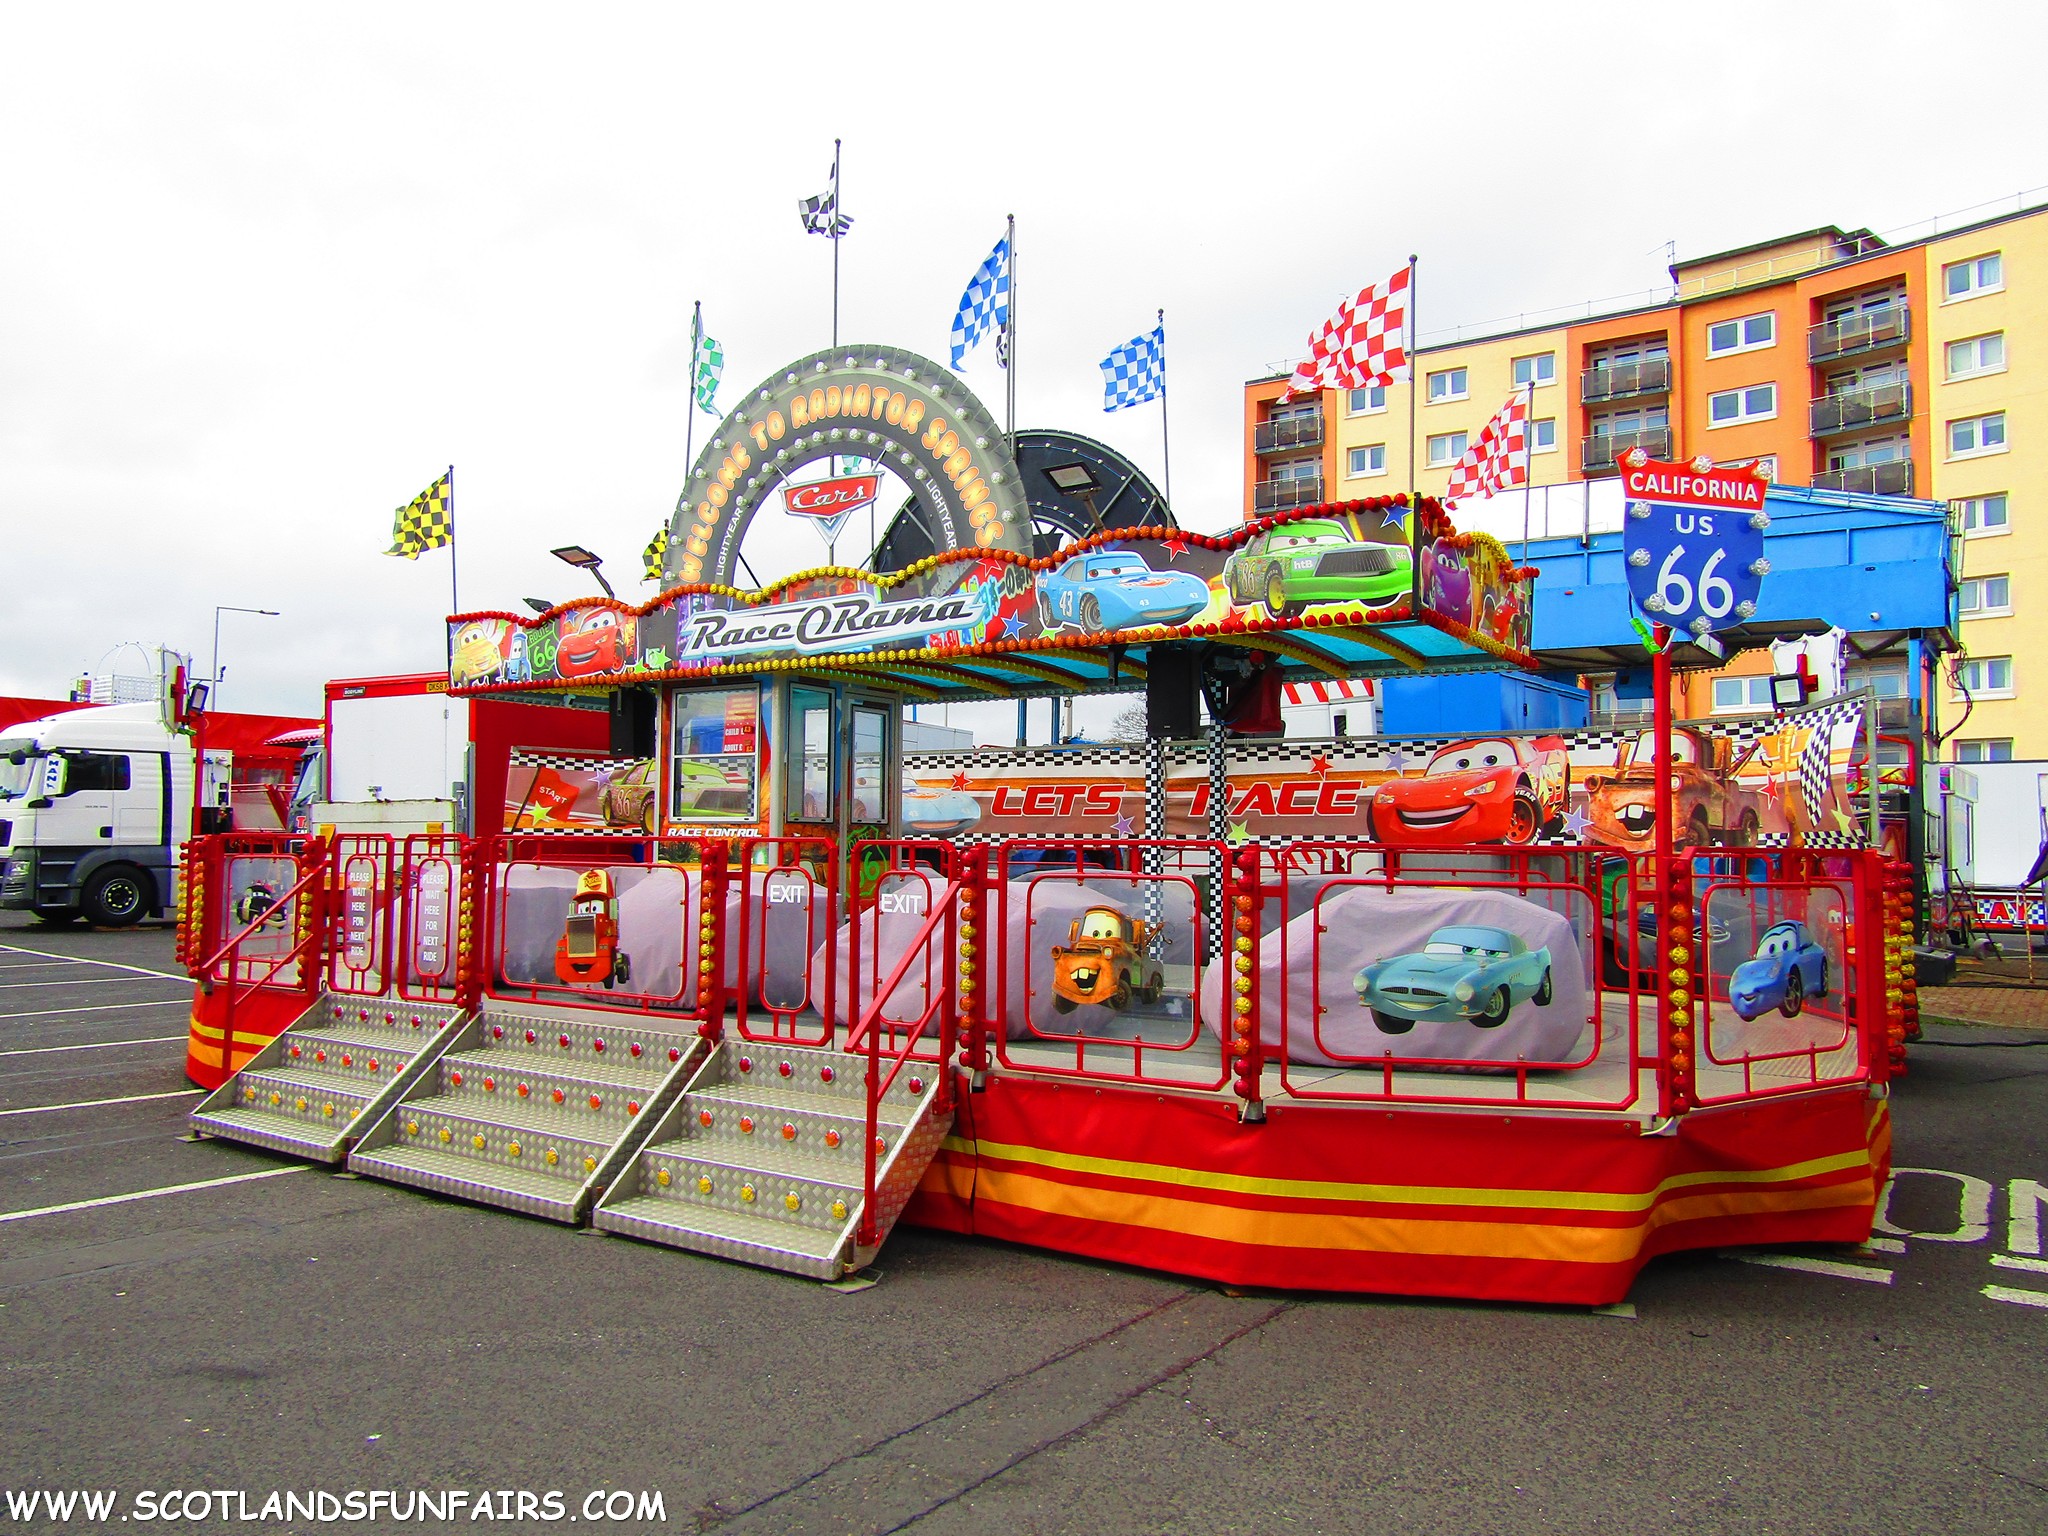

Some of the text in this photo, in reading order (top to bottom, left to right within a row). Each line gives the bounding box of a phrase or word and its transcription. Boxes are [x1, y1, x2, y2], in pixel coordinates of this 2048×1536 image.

[679, 383, 1005, 583] WELCOME TO RADIATOR SPRINGS
[1629, 473, 1758, 502] CALIFORNIA
[792, 485, 868, 510] Cars
[926, 478, 958, 550] LIGHTYEAR
[1675, 513, 1714, 537] US
[716, 508, 744, 577] LIGHTYEAR
[1241, 560, 1256, 594] 86
[1656, 544, 1734, 619] 66
[1059, 590, 1074, 618] 43
[1139, 599, 1150, 607] 43
[533, 638, 555, 668] 66
[539, 786, 568, 804] START
[615, 788, 631, 817] 86
[989, 780, 1364, 817] LETS RACE
[667, 828, 762, 838] RACE CONTROL
[349, 872, 370, 883] PLEASE
[422, 874, 444, 884] PLEASE
[352, 887, 366, 897] WAIT
[425, 890, 440, 900] WAIT
[769, 884, 804, 904] EXIT
[351, 901, 366, 912] HERE
[424, 905, 440, 916] HERE
[881, 893, 922, 914] EXIT
[352, 916, 364, 926] FOR
[425, 920, 438, 931] FOR
[350, 931, 365, 941] NEXT
[423, 936, 439, 946] NEXT
[351, 946, 364, 956] RIDE
[422, 951, 437, 962] RIDE
